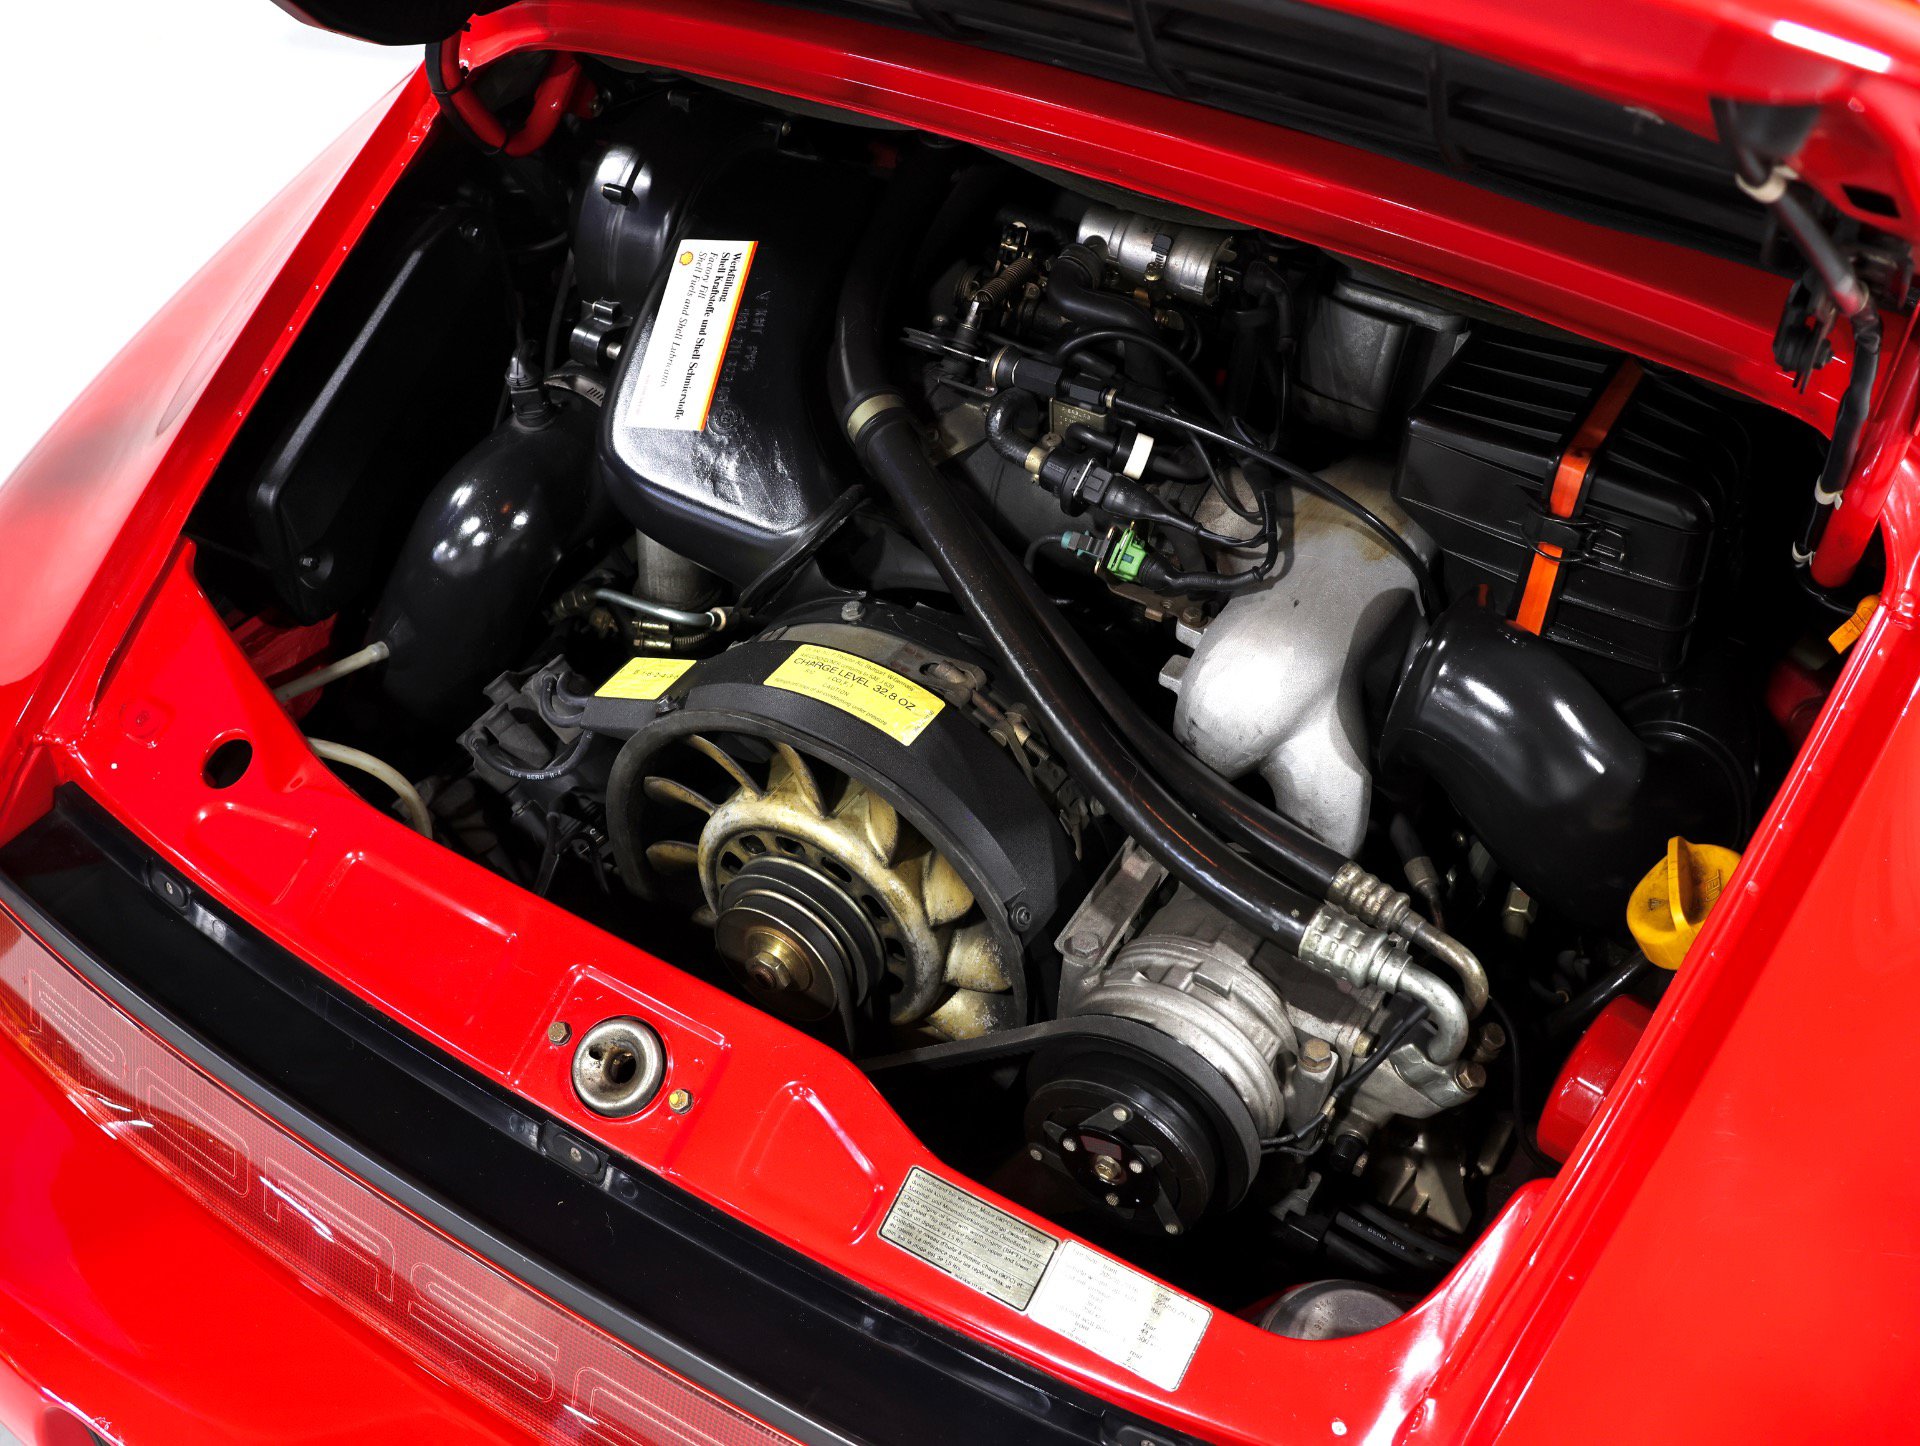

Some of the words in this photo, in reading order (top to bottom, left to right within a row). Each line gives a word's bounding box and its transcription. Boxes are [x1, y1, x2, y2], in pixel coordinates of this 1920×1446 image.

[693, 251, 708, 272] Shell
[699, 251, 719, 282] Factory
[716, 252, 730, 272] Shell
[685, 274, 701, 296] Fuels
[718, 252, 742, 302] Werkfüllung
[696, 284, 709, 299] Fill
[703, 275, 723, 317] Kraftstoffe
[680, 298, 693, 315] and
[673, 317, 688, 339] Shell
[697, 319, 710, 335] und
[690, 337, 705, 359] Shell
[658, 341, 681, 387] Lubricants
[673, 361, 698, 420] Schmierstoffe
[793, 657, 839, 674] CHARGE
[838, 669, 869, 687] LEVEL
[898, 697, 916, 711] OZ
[822, 683, 849, 697] CAUTION
